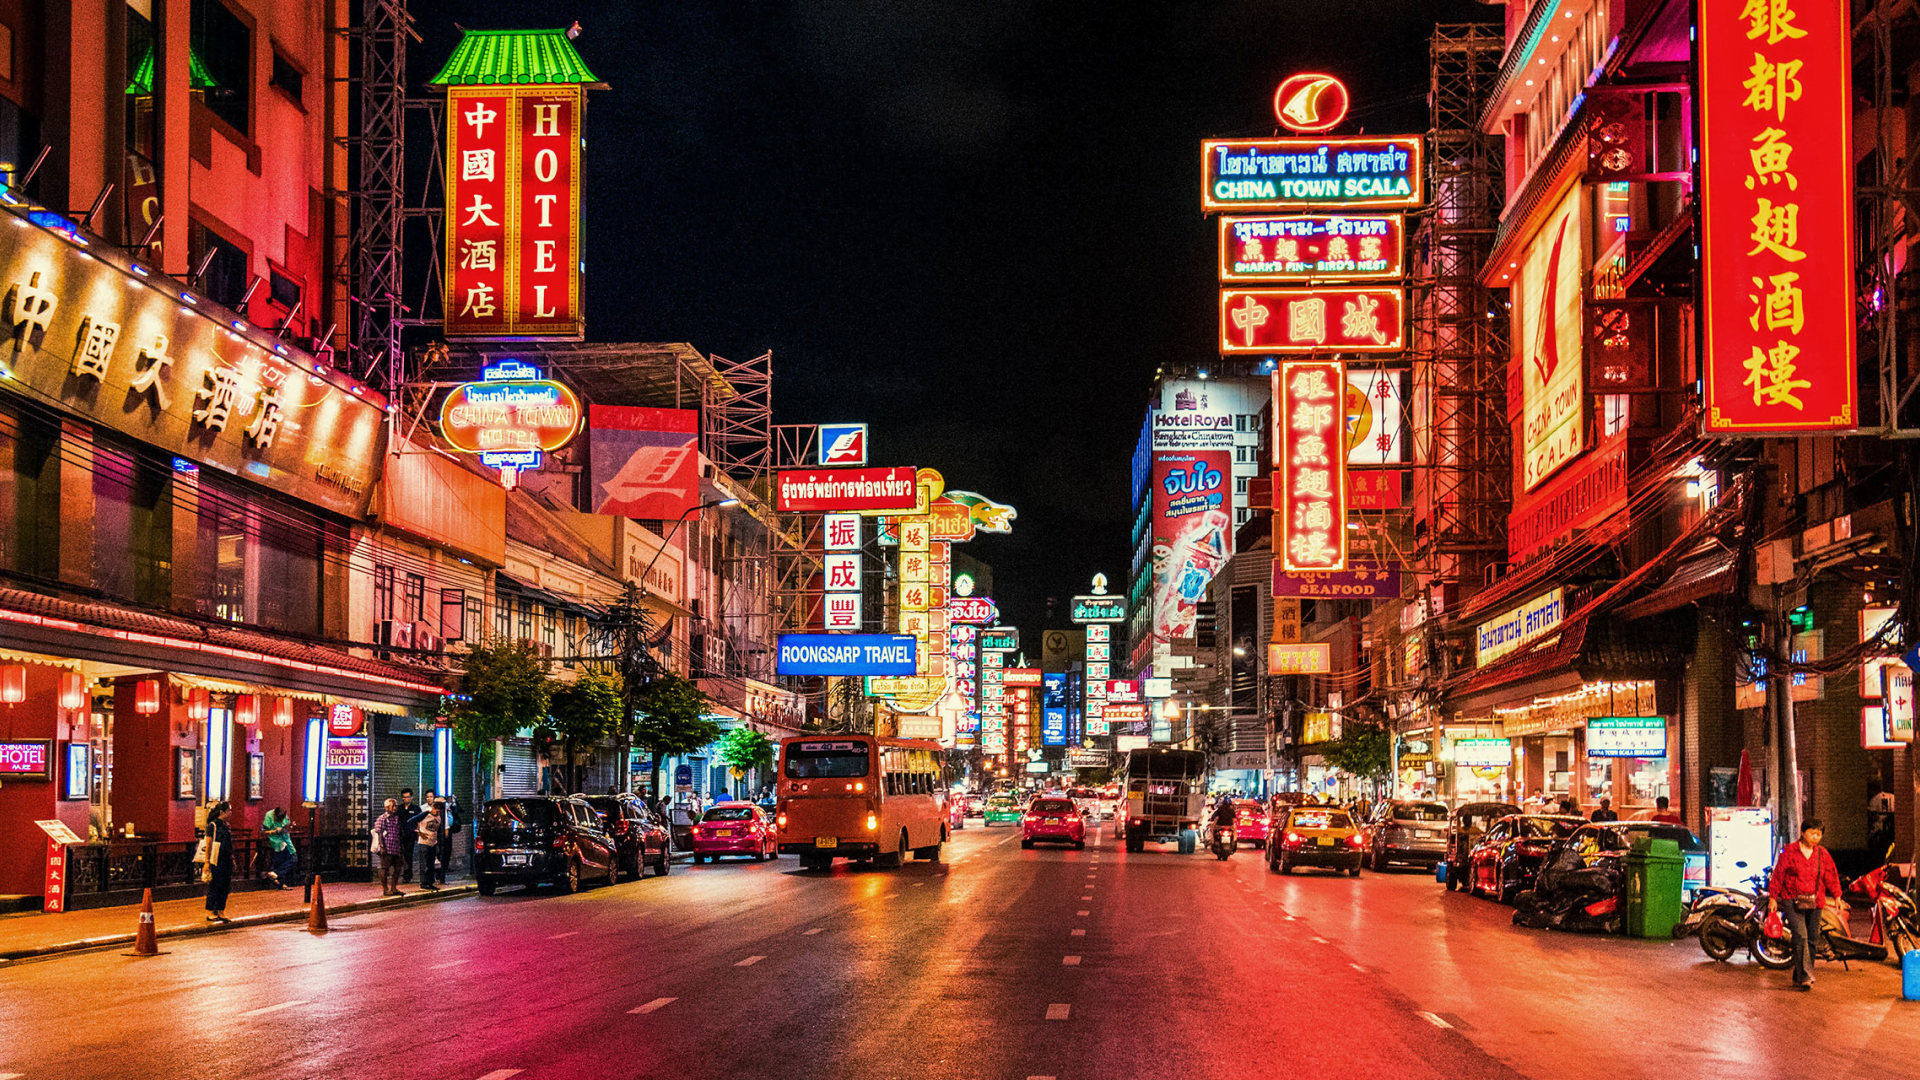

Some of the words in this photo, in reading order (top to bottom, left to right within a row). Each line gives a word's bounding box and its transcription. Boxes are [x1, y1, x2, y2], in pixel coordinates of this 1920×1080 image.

[1215, 180, 1276, 199] CHINA
[1281, 179, 1340, 197] TOWN
[1344, 177, 1410, 196] SCALA
[460, 102, 500, 319] 中國大酒店
[533, 104, 561, 318] HOTEL
[1739, 0, 1812, 411] 銀都魚翅酒樓
[1235, 261, 1282, 272] SHARK'S
[1317, 259, 1354, 271] BIRD'S
[1357, 259, 1387, 271] NEST
[1231, 295, 1385, 346] 中國城
[13, 271, 285, 449] 中國大酒店
[450, 405, 509, 427] CHINA
[515, 405, 572, 426] TOWN
[1155, 413, 1192, 427] Hotel
[1194, 413, 1232, 430] Royal
[1526, 404, 1551, 443] CHINA
[1554, 382, 1577, 417] TOWN
[479, 429, 540, 446] HOTEL
[1290, 370, 1337, 564] 銀都魚翅酒樓
[1527, 427, 1577, 485] SCALA
[782, 468, 912, 509] รุ่งทรัพย์การท่องเที่ยว
[1164, 460, 1222, 495] จับใจ
[1346, 539, 1378, 550] EST
[829, 519, 856, 626] 振成豐
[1300, 584, 1375, 595] SEAFOOD
[782, 645, 860, 663] ROONGSARP
[864, 645, 912, 663] TRAVEL
[333, 711, 352, 721] ZEN
[0, 750, 45, 764] HOTEL
[821, 742, 832, 750] 40
[331, 754, 365, 765] HOTEL
